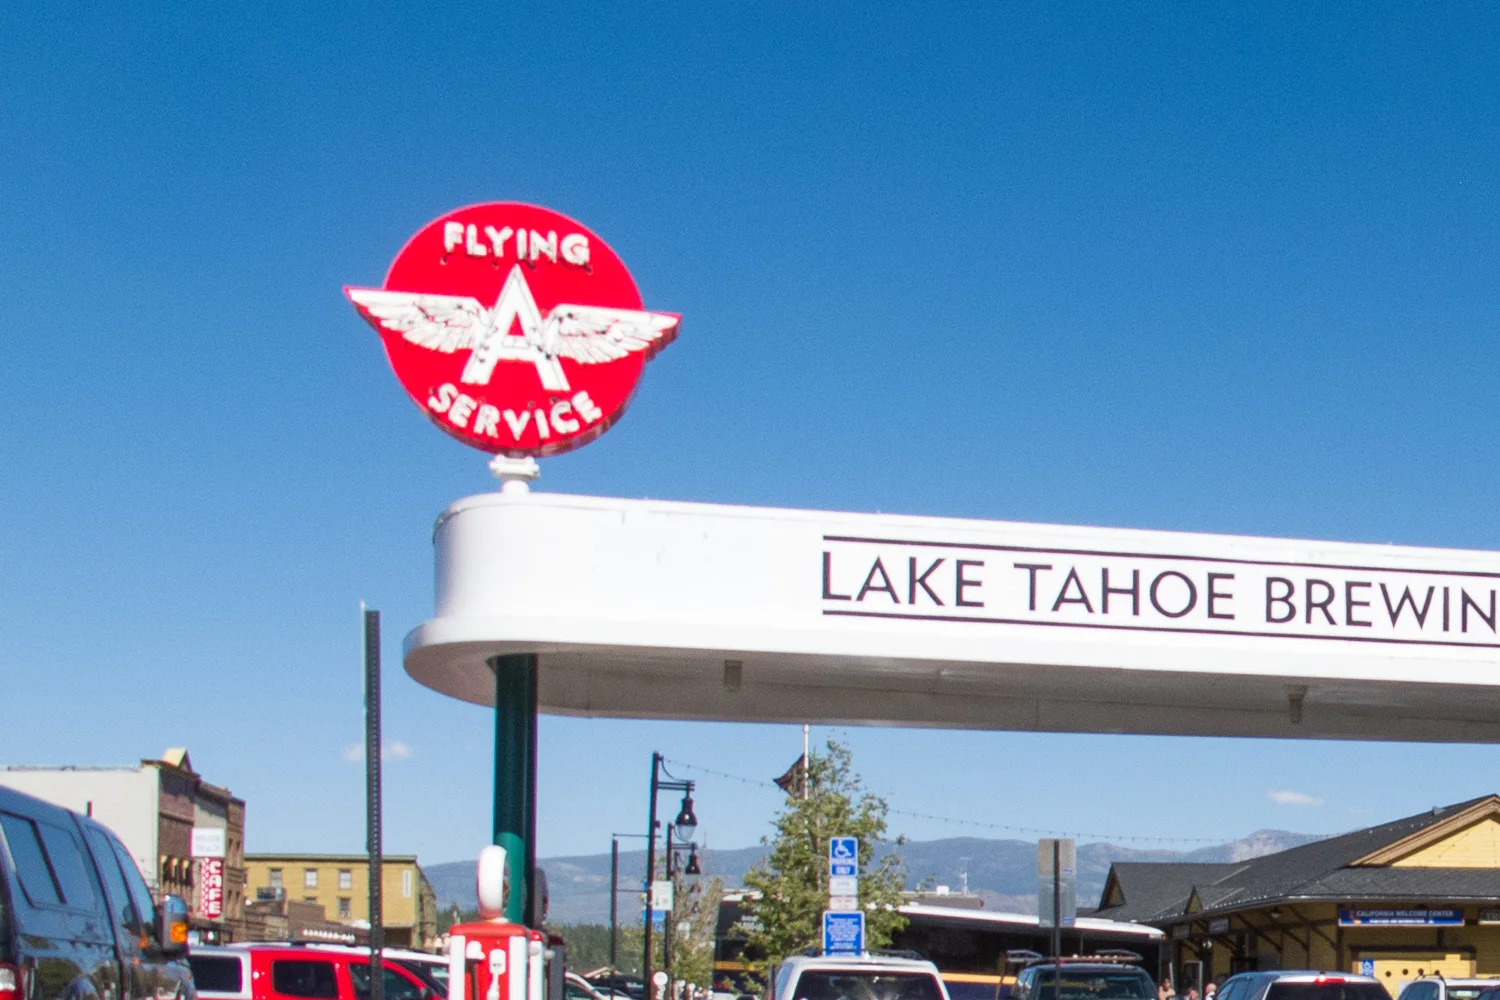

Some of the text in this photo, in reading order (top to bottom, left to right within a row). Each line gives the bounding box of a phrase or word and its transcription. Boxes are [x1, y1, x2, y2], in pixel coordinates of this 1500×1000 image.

[443, 222, 591, 264] FLYING
[460, 263, 571, 391] A
[427, 382, 603, 441] SERVICE
[822, 551, 985, 608] LAKE
[1013, 562, 1236, 621] TAHOE
[208, 860, 222, 914] CAFE
[1356, 910, 1454, 918] CALIFORNIA WELCOME CENTER
